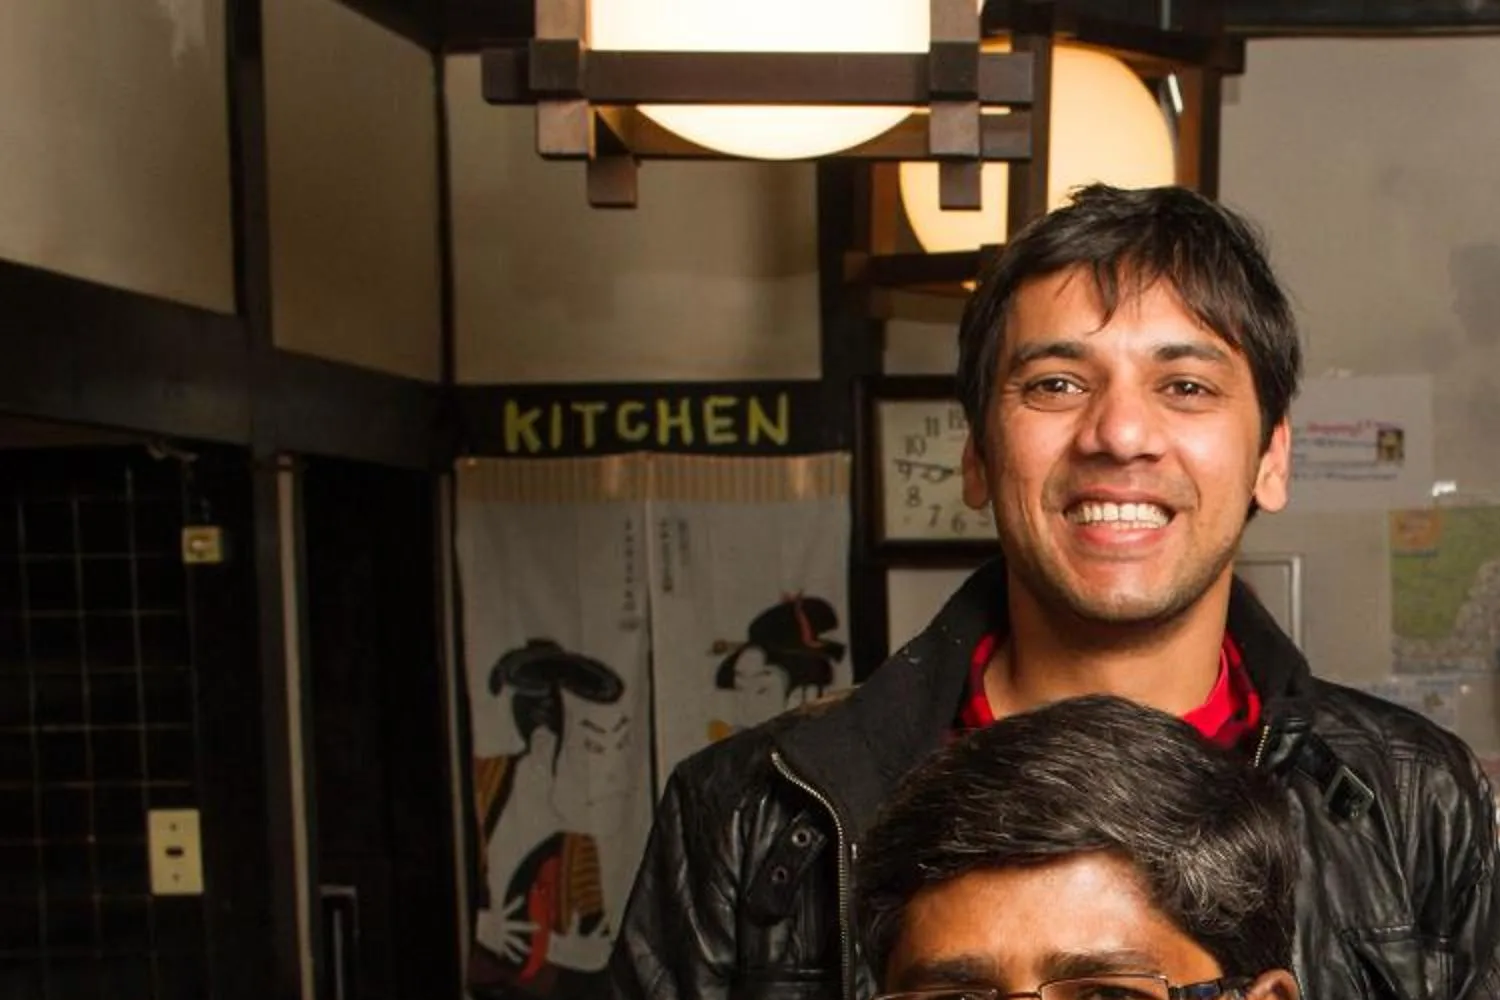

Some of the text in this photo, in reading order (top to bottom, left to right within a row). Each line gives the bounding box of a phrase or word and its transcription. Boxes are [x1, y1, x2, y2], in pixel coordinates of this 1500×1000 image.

[504, 393, 790, 453] KITCHEN
[925, 415, 940, 438] 11
[905, 434, 927, 457] 10
[905, 485, 922, 508] 8
[928, 503, 943, 528] 7
[950, 509, 968, 534] 6
